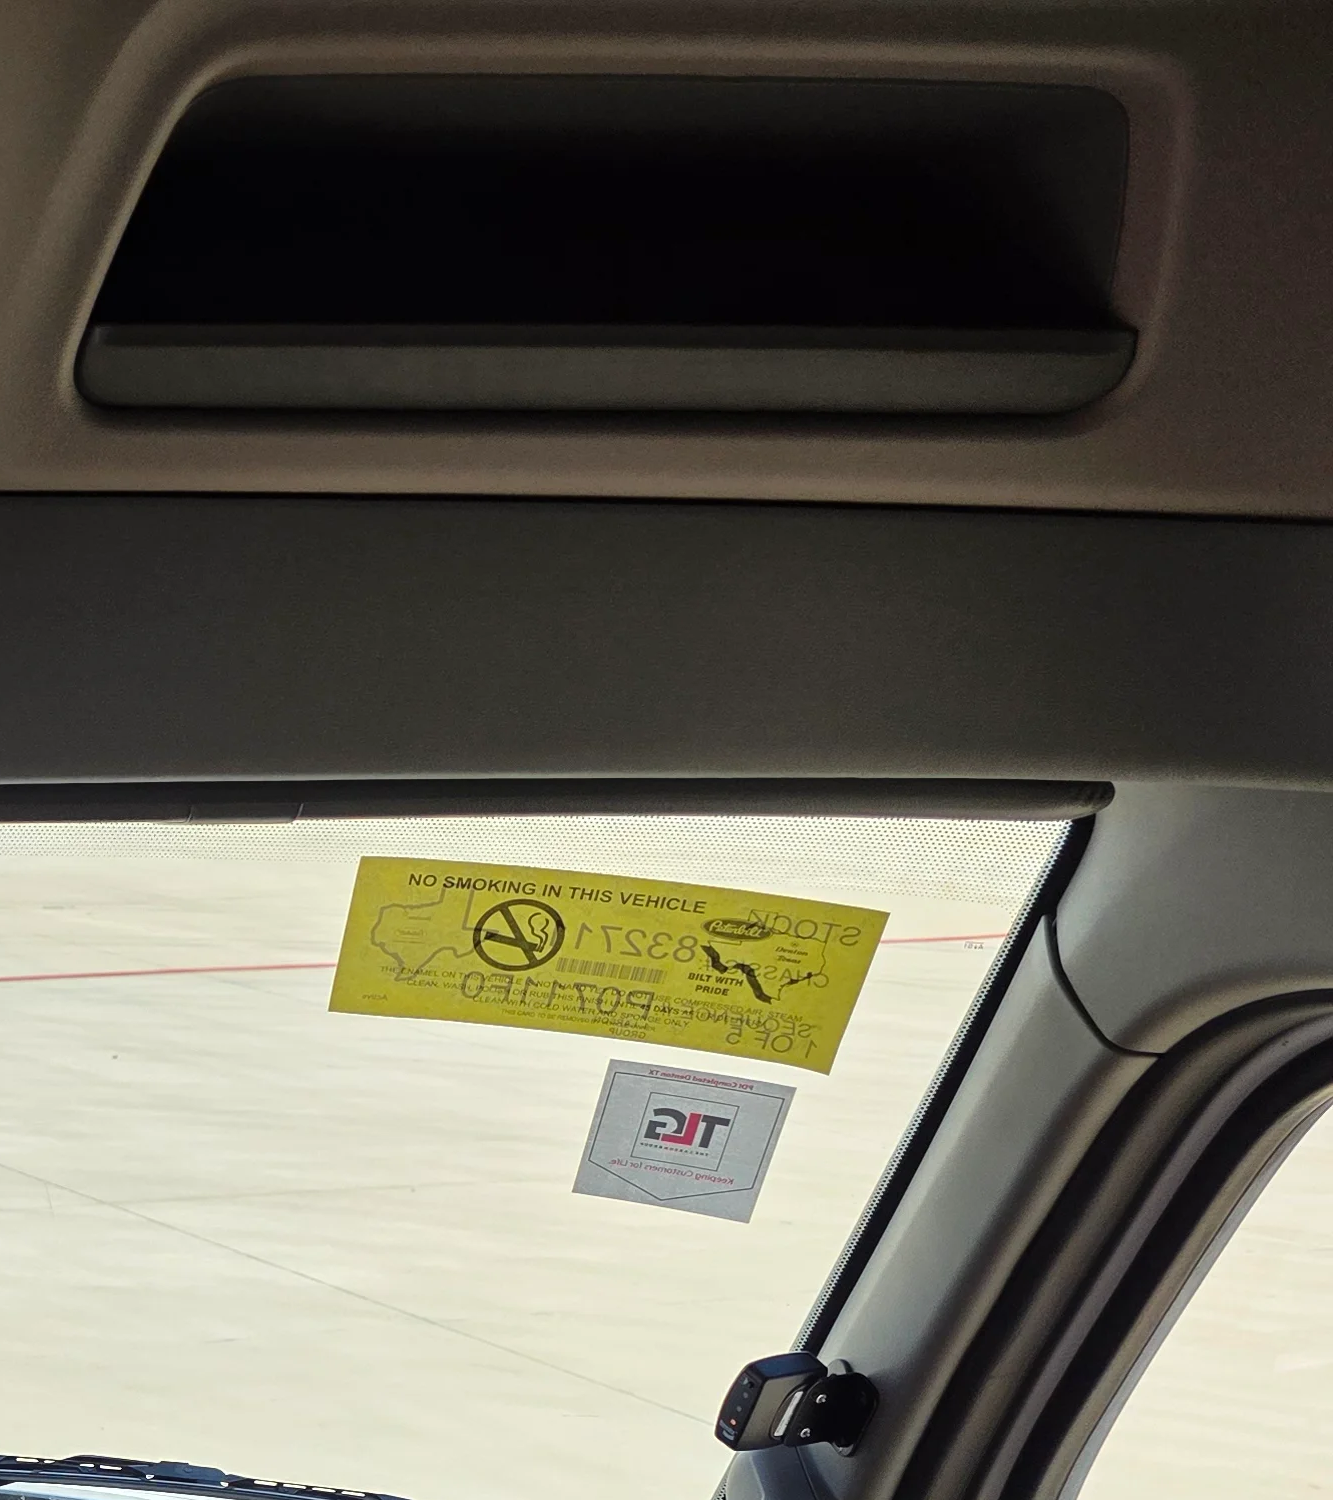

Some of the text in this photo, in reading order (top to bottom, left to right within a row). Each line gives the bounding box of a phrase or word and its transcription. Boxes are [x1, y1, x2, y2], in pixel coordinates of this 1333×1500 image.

[408, 873, 707, 914] NO SMOKING IN THIS VEHICLE
[708, 919, 770, 938] Peterbilt
[688, 971, 744, 988] BILT WITH
[695, 984, 730, 997] PRIDE
[652, 1004, 680, 1016] DAYS
[767, 1011, 805, 1022] STEAM
